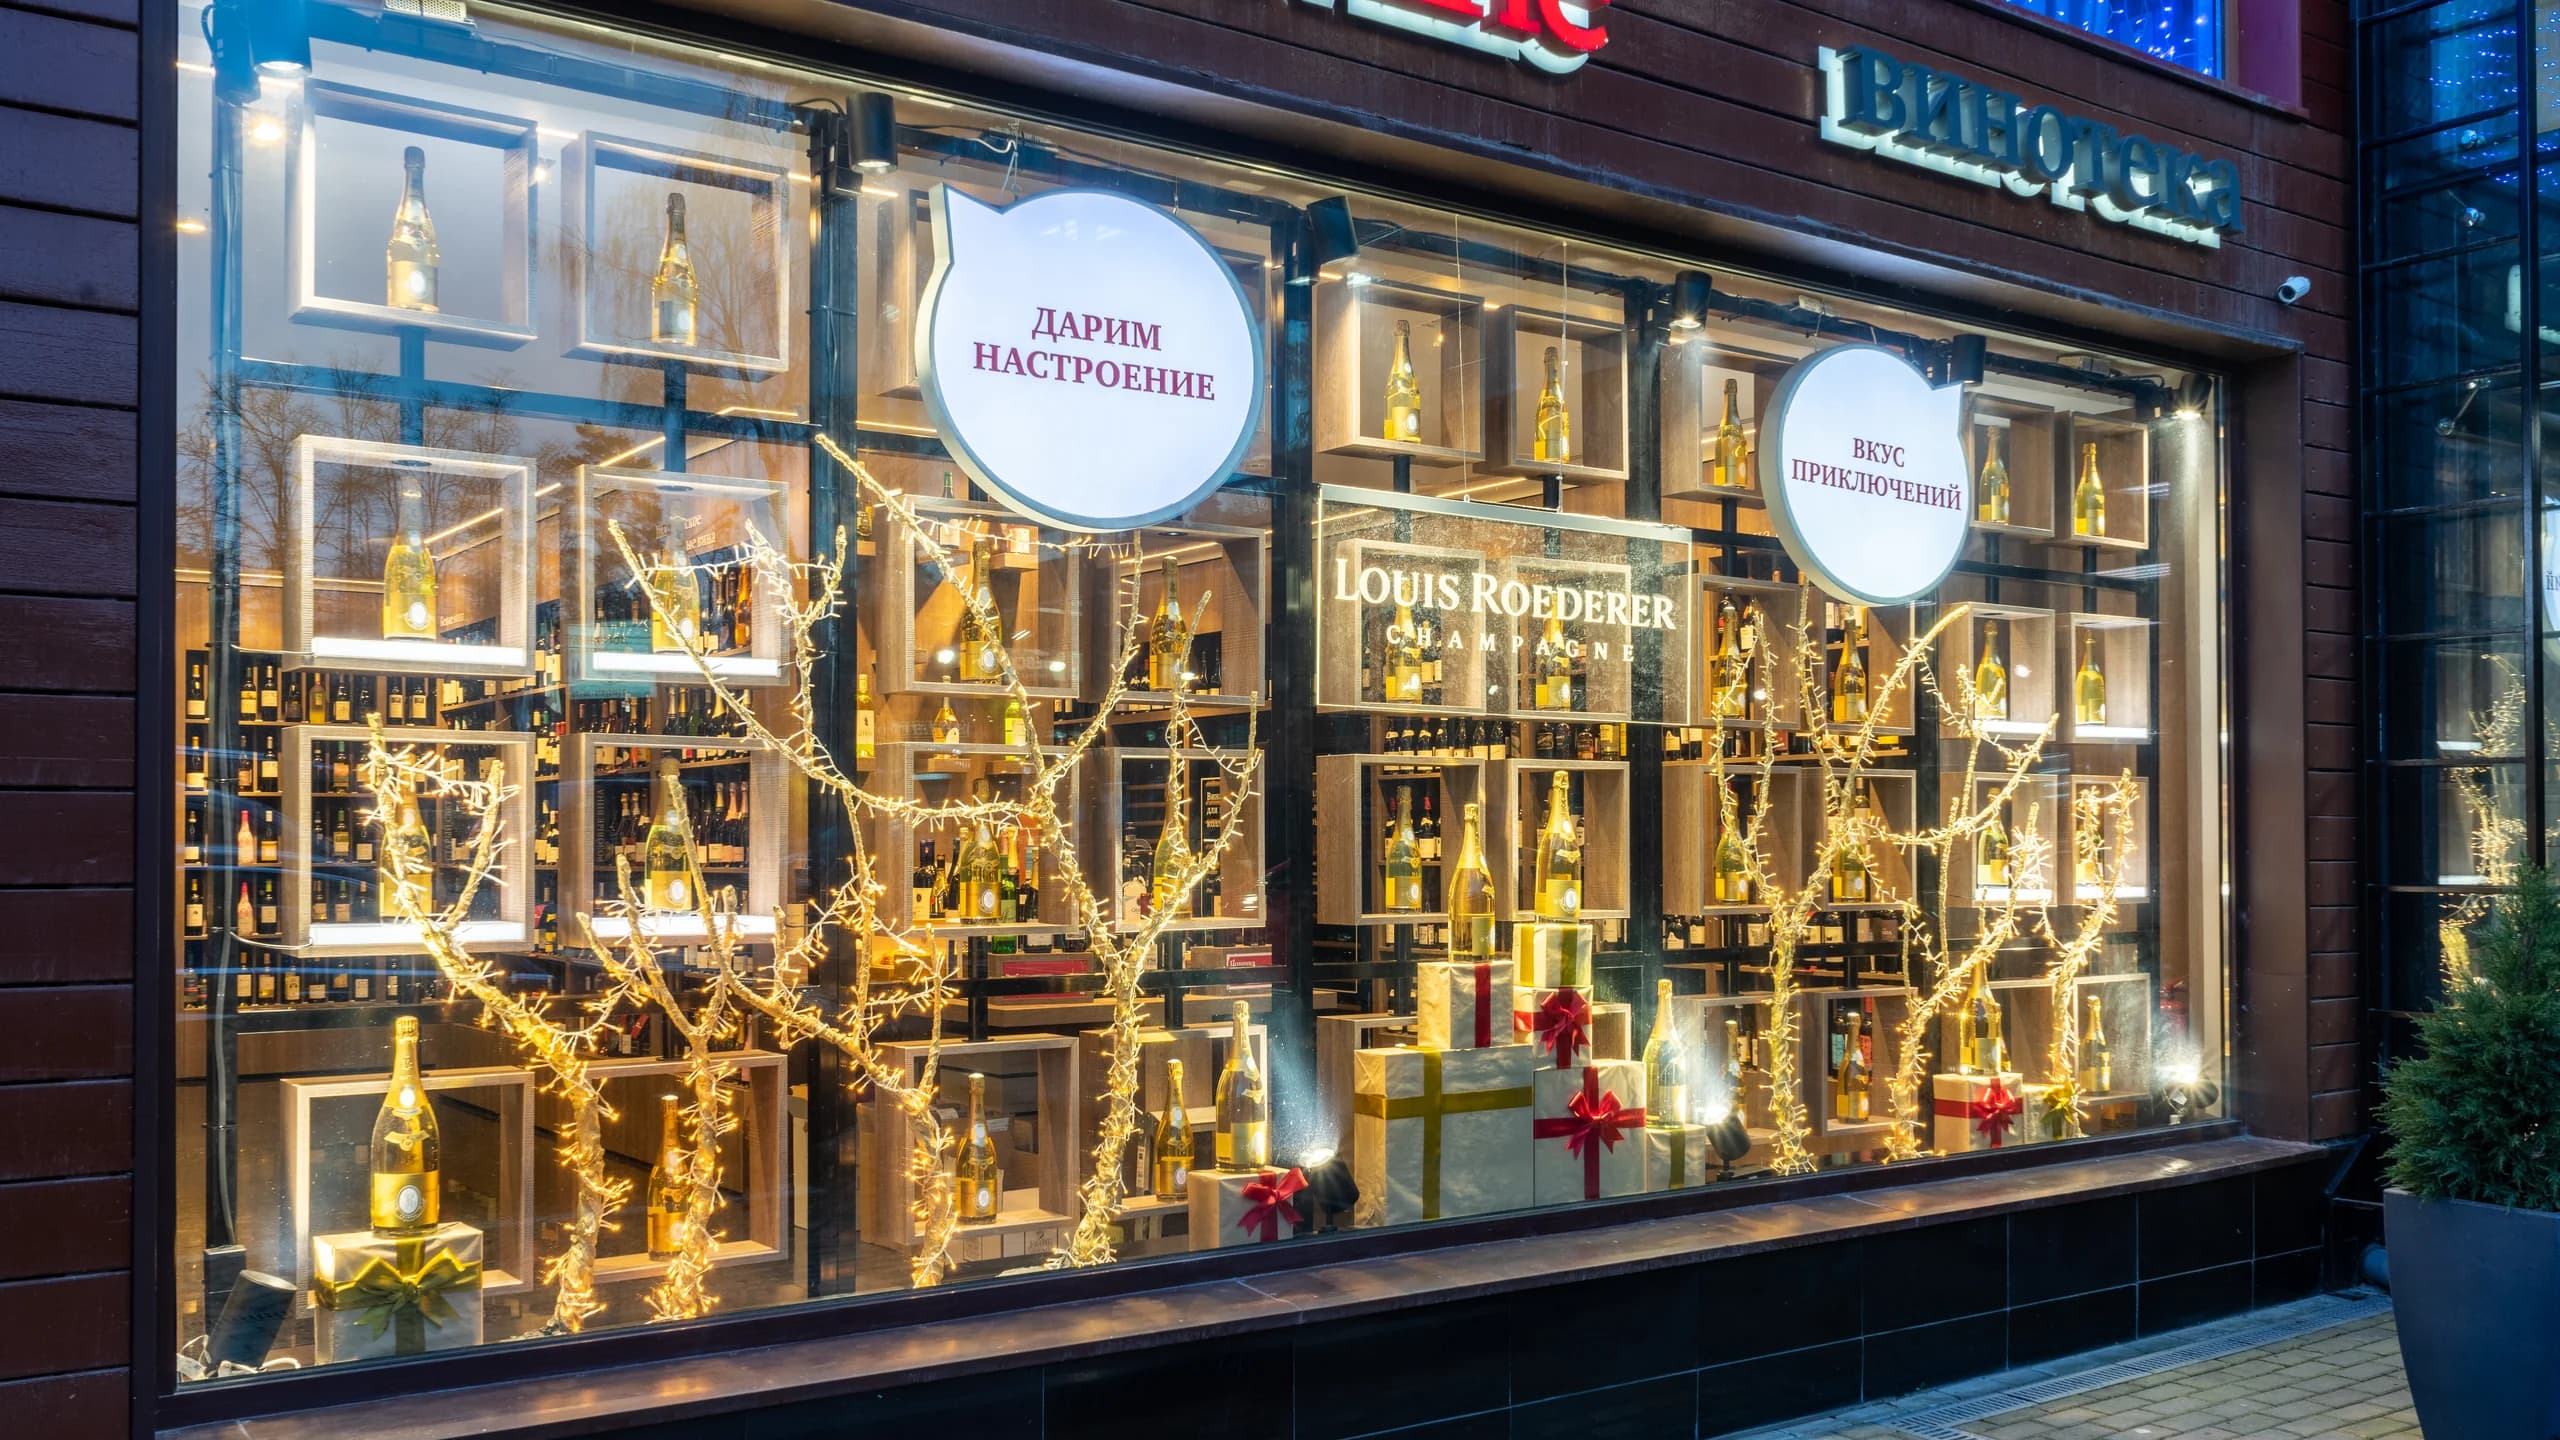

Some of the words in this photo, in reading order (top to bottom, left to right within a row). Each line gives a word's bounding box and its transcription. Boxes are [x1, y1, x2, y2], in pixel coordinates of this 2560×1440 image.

[1031, 306, 1162, 351] ДАРИМ
[973, 342, 1215, 401] НАСТРОЕНИЕ
[1853, 438, 1904, 468] ВКУС
[1792, 459, 1961, 511] ПРИКЛЮЧЕНИЙ
[1334, 558, 1460, 611] LOUIS
[1471, 572, 1677, 630] ROEDERER
[1386, 624, 1635, 662] CHAMPAGNE
